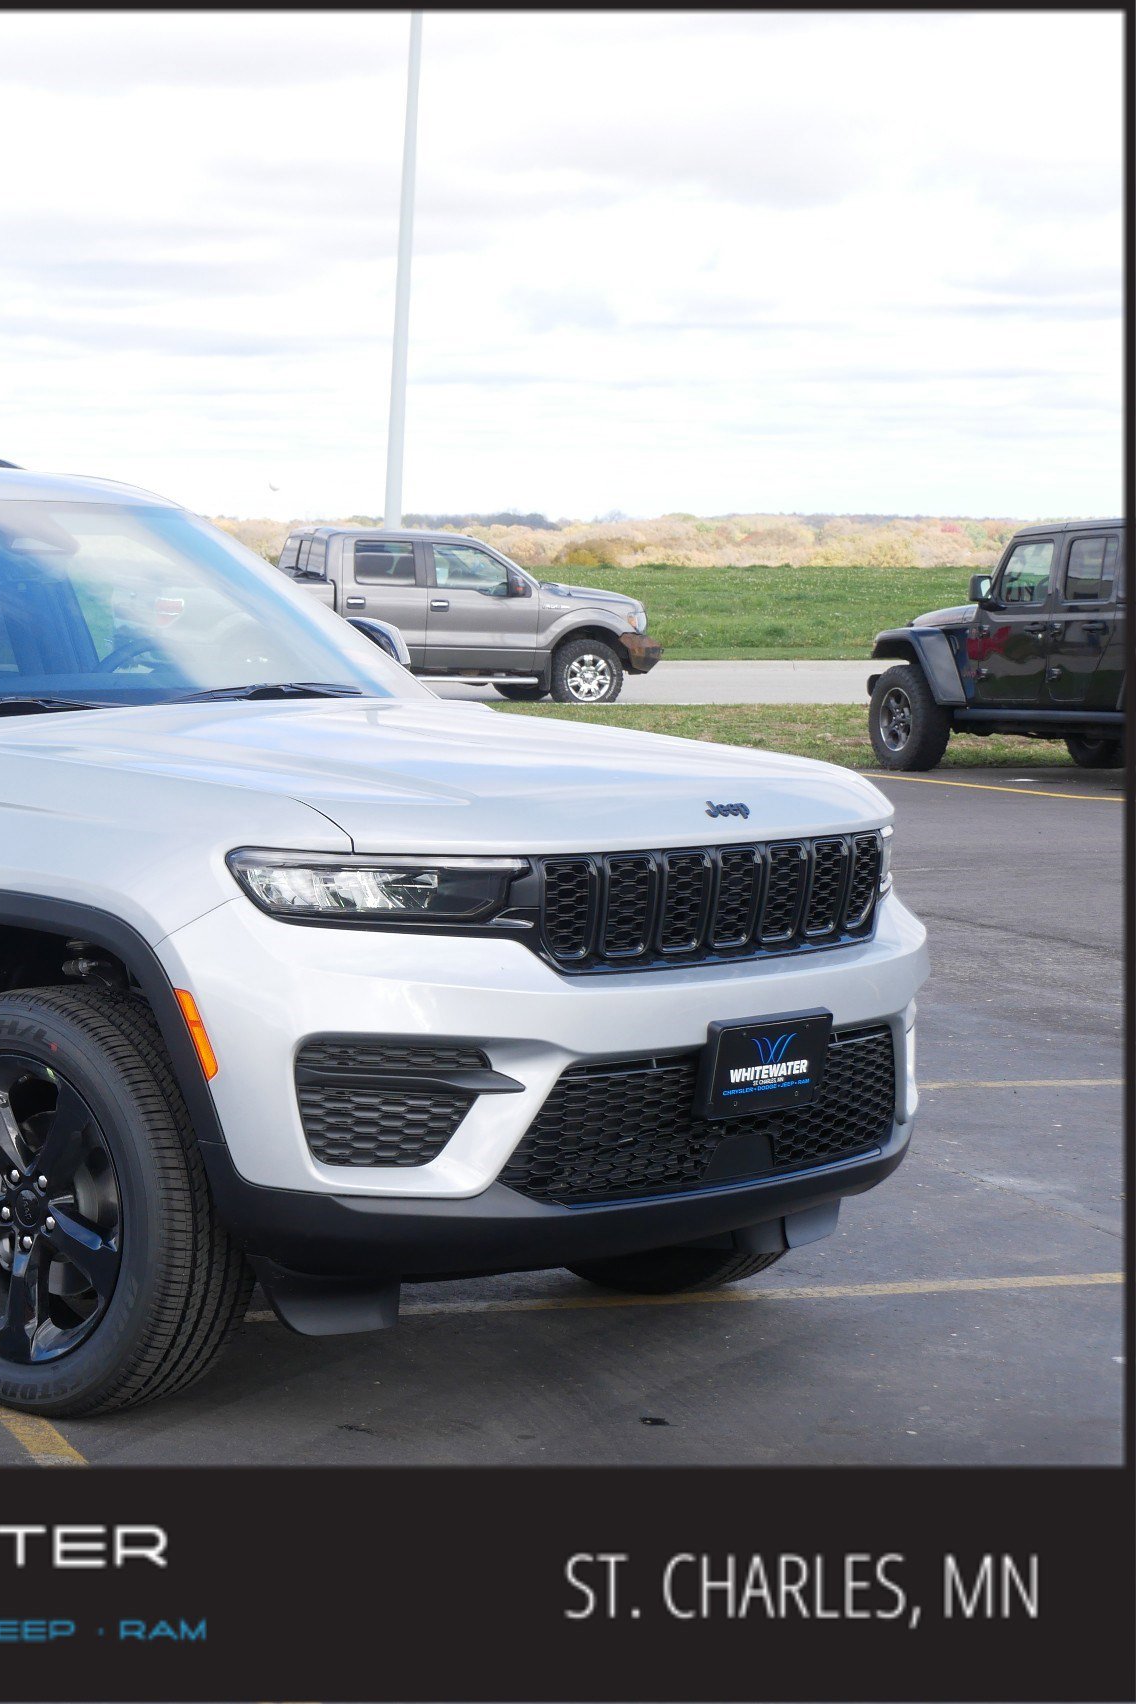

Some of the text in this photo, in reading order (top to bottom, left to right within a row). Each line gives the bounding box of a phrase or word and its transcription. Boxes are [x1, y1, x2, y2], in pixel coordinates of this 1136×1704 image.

[705, 800, 750, 819] Jeep
[729, 1059, 808, 1084] WHITEWATER
[797, 1078, 810, 1086] RAM
